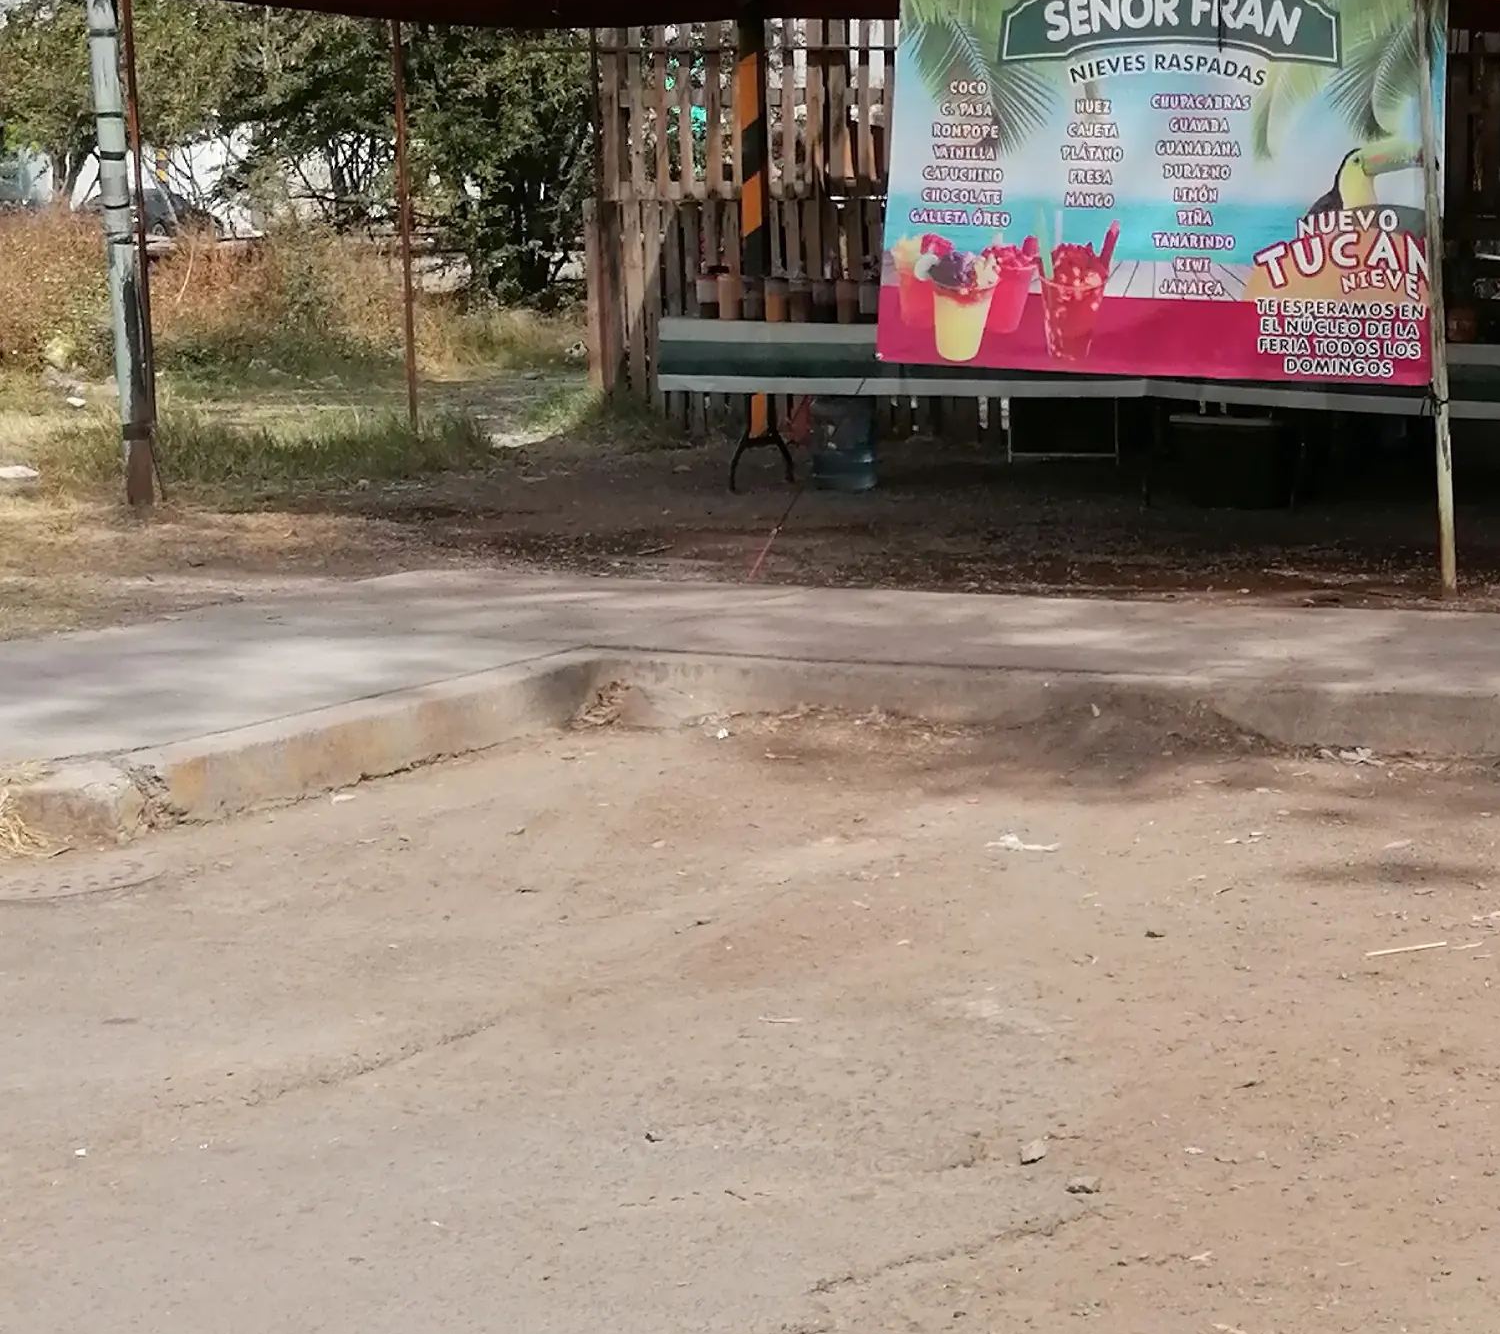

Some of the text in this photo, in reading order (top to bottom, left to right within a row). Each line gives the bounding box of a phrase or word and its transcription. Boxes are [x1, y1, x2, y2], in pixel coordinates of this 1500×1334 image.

[1069, 53, 1268, 87] NIEVES RASPADAS
[950, 80, 987, 95] COCO
[959, 103, 993, 117] PASA
[1075, 98, 1112, 115] NUEZ
[1150, 93, 1251, 111] CHUPACABRAS
[932, 123, 999, 139] ROMPOPE
[1066, 122, 1119, 138] CAJETA
[1169, 117, 1230, 134] GUAYABA
[933, 145, 996, 161] VAINILLA
[1060, 142, 1124, 162] PLÁTANO
[1155, 140, 1241, 158] GUANABANA
[923, 166, 1004, 183] CAPUCHINO
[1068, 169, 1113, 185] FRESA
[1163, 164, 1231, 180] DURAZNO
[922, 188, 1002, 205] CHOCOLATE
[1064, 191, 1115, 208] MANGO
[1173, 185, 1219, 203] LIMÓN
[909, 209, 970, 226] GALLETA
[1176, 209, 1214, 227] PIÑA
[1296, 209, 1399, 238] NUEVO
[1151, 232, 1235, 250] TAMARINDO
[1174, 256, 1211, 273] KIWI
[1253, 230, 1430, 288] TUCAN
[1159, 279, 1225, 297] JAMAICA
[1341, 269, 1421, 301] NIEVE
[1257, 298, 1425, 319] TE ESPERAMOS EN
[1261, 315, 1419, 339] EL NÚCLEO DE LA
[1258, 338, 1421, 358] FERIA TODOS LOS
[1285, 358, 1394, 377] DOMINGOS
